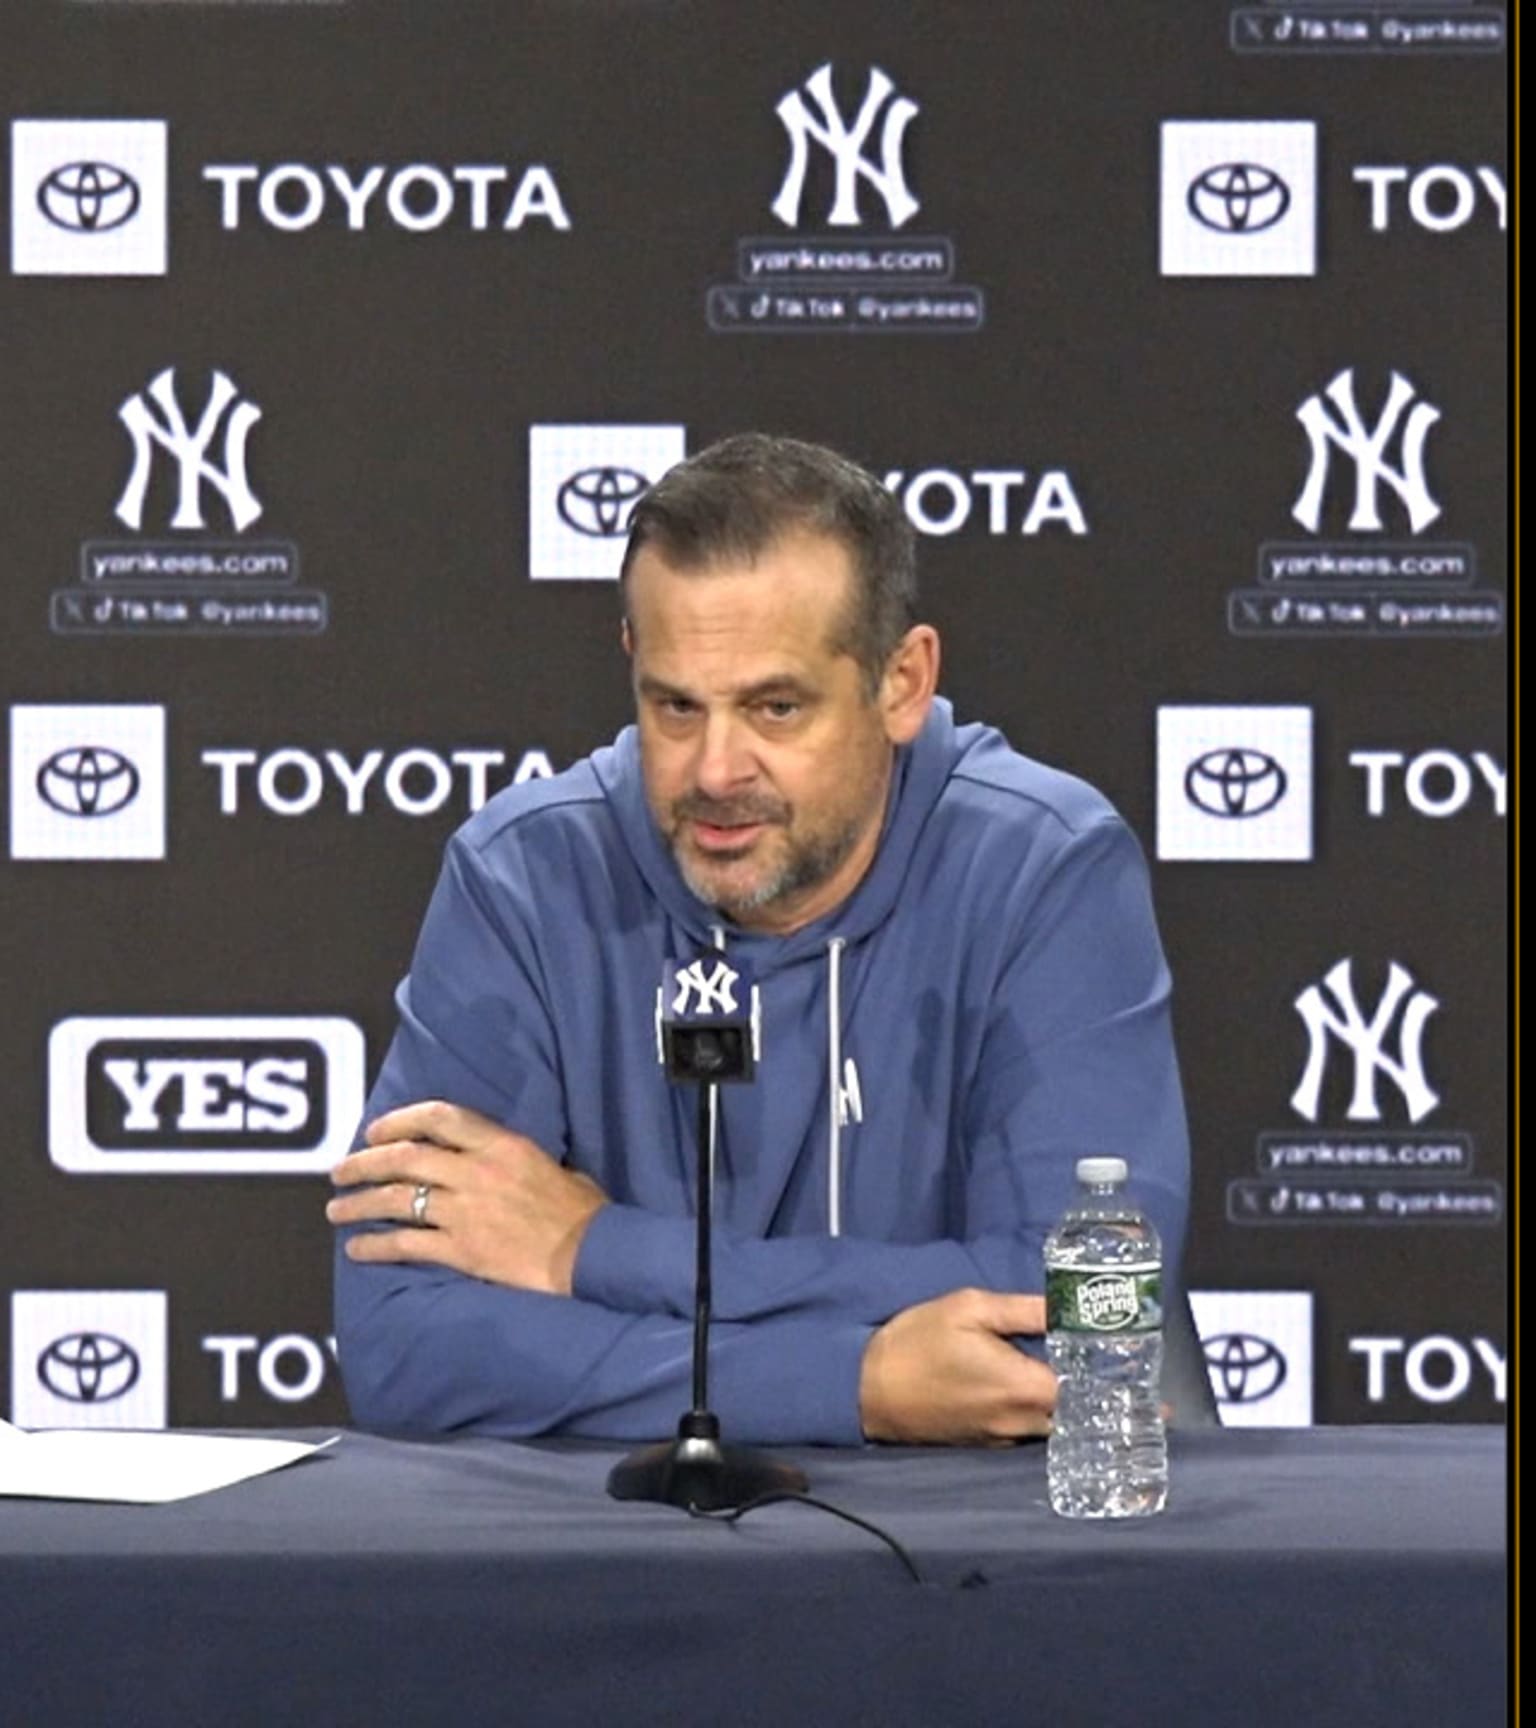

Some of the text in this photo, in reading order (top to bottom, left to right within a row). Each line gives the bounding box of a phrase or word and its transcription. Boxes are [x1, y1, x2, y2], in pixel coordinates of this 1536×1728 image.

[203, 165, 570, 231] TOYOTA
[751, 249, 943, 274] yankees.com
[883, 469, 1087, 536] OTA
[93, 553, 288, 579] yankees.com
[1271, 554, 1464, 579] yankees.com
[104, 1058, 309, 1132] YES
[1270, 1144, 1462, 1168] yankees.com
[1077, 1276, 1136, 1304] Poland
[1080, 1296, 1139, 1323] Spring
[204, 1335, 338, 1401] TO
